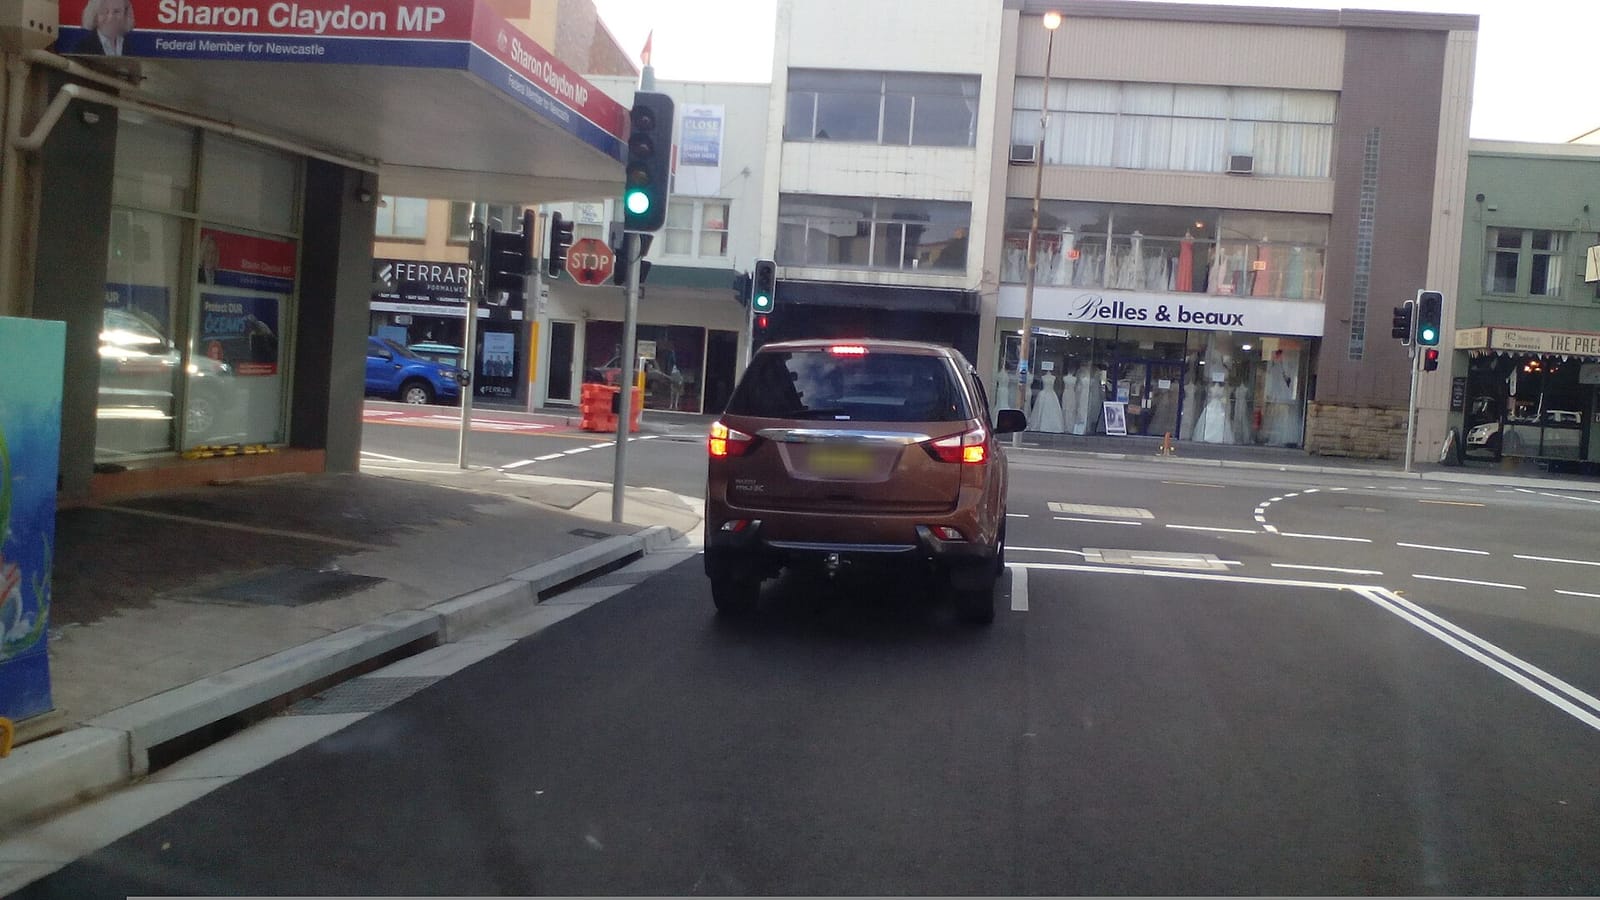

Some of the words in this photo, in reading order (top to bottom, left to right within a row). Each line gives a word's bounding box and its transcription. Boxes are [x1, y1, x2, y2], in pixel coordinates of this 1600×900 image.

[158, 0, 258, 26] Sharon
[268, 2, 386, 33] Claydon
[397, 7, 445, 31] MP
[156, 39, 196, 50] Federal
[199, 40, 244, 52] Member
[248, 43, 263, 53] for
[266, 43, 325, 55] Newcastle
[511, 38, 541, 77] Sharon
[543, 61, 574, 100] Claydon
[575, 84, 588, 107] MP
[685, 119, 719, 129] CLOSE
[572, 253, 609, 269] STOP
[396, 263, 468, 284] FERRAR
[427, 284, 468, 293] FORMALWEA
[228, 303, 243, 314] OUR
[1068, 294, 1147, 321] Belles
[1155, 305, 1171, 322] &
[1178, 305, 1244, 326] beaux
[1551, 335, 1571, 351] THE
